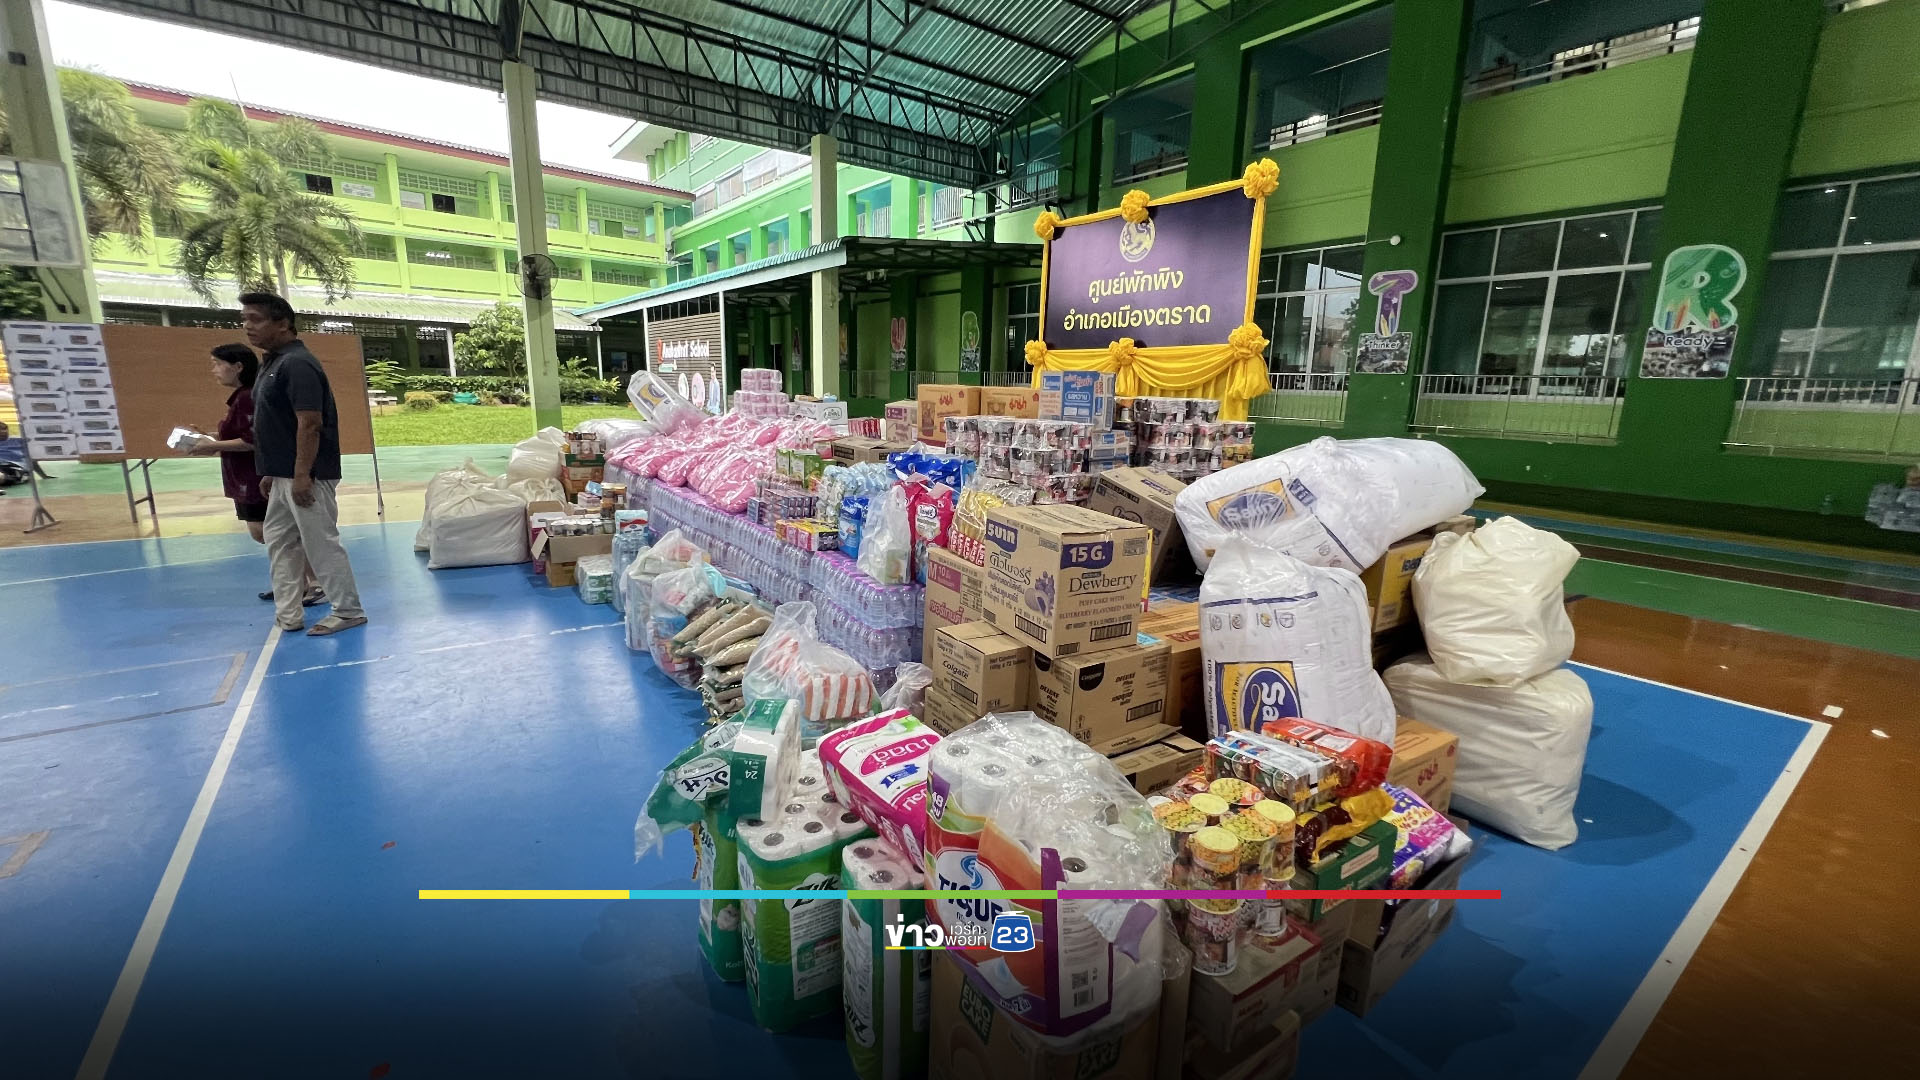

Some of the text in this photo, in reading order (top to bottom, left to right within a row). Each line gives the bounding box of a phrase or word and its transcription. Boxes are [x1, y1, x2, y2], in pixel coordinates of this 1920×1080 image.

[1089, 267, 1185, 303] ศูนย์พักพิง
[1657, 244, 1747, 334] R
[1368, 270, 1419, 338] T
[1064, 303, 1212, 332] อำเภอเมืองตราด
[690, 339, 710, 358] School
[1367, 339, 1401, 351] Thinker
[1664, 335, 1714, 351] Ready
[1069, 546, 1088, 563] 15
[1090, 545, 1106, 561] G.
[928, 561, 937, 580] M
[1069, 574, 1138, 593] Dewberry
[942, 660, 969, 680] Colgate
[745, 770, 758, 780] 24
[962, 984, 992, 1020] EURO
[960, 1001, 992, 1041] CAKE
